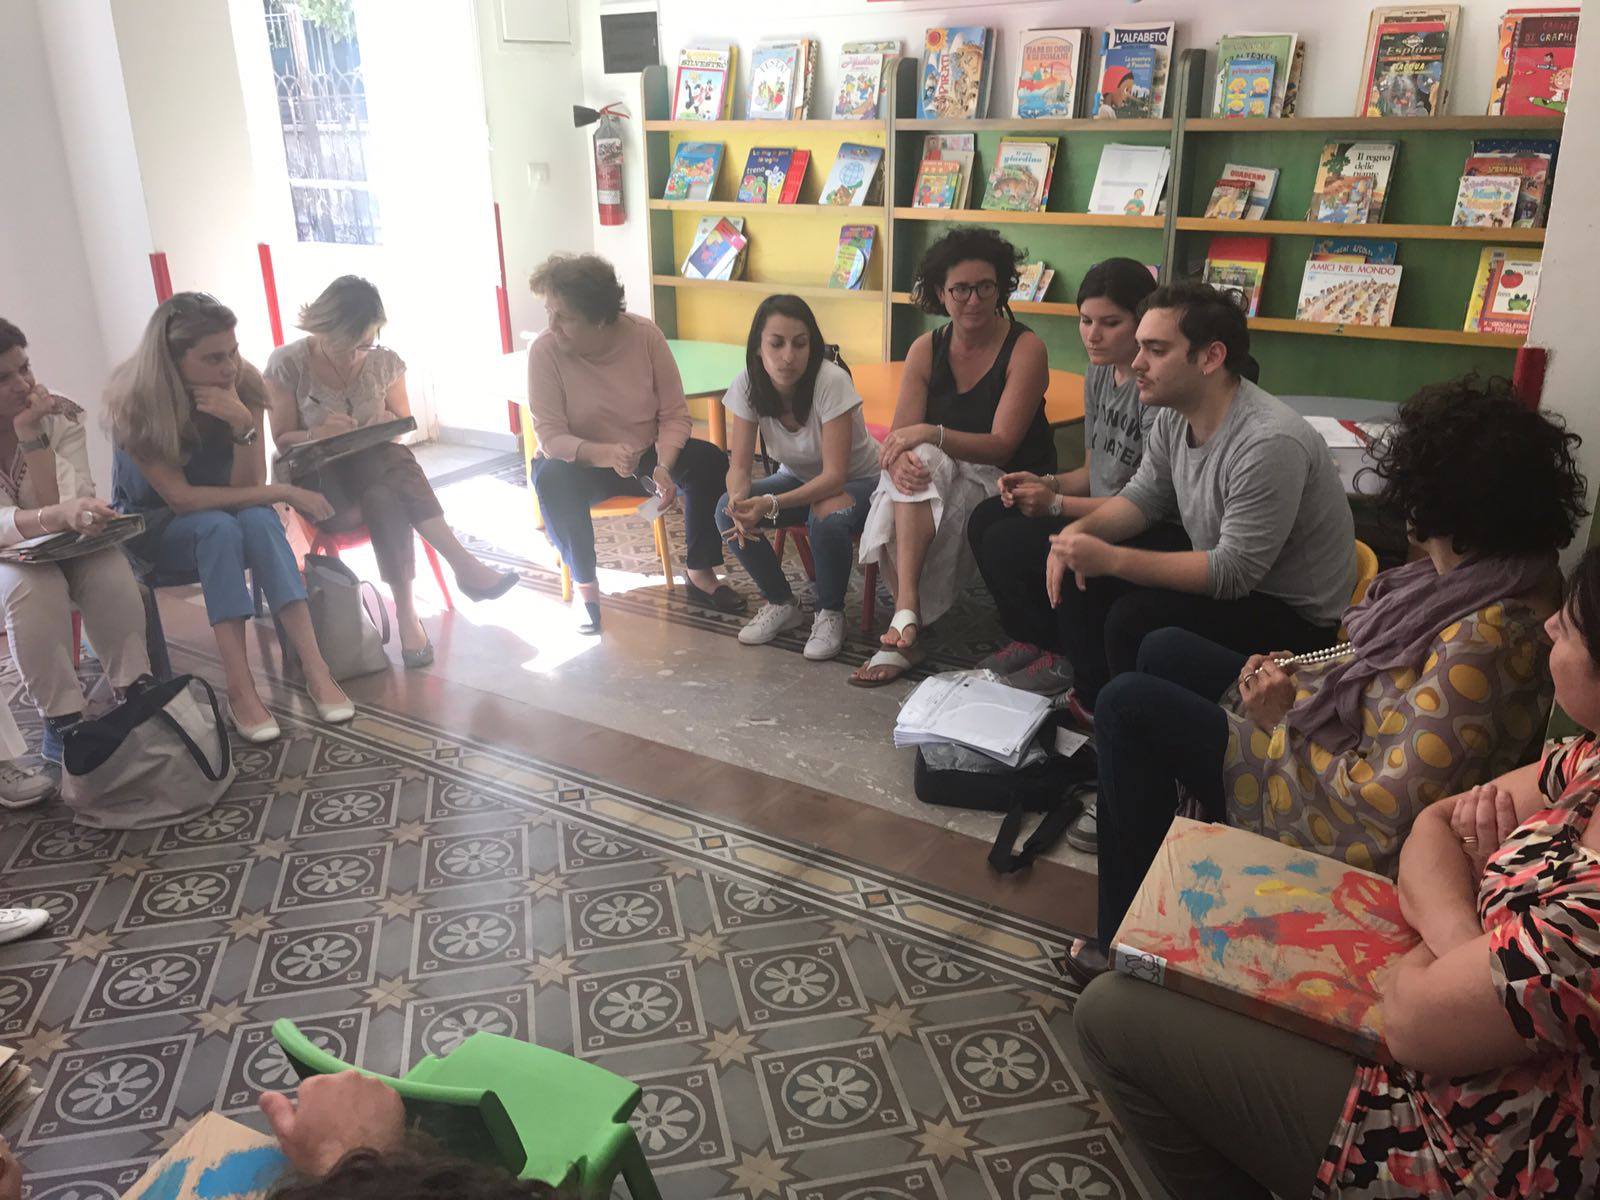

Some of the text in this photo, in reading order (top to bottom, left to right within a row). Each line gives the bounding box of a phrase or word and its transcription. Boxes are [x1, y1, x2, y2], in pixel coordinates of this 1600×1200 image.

[1115, 31, 1167, 43] L'ALFABETO
[1004, 155, 1042, 164] giardino
[1357, 152, 1391, 163] Il regno
[1354, 161, 1374, 170] delle
[1230, 170, 1266, 181] QUADERNO
[1310, 263, 1396, 275] AMICI NEL MONDO
